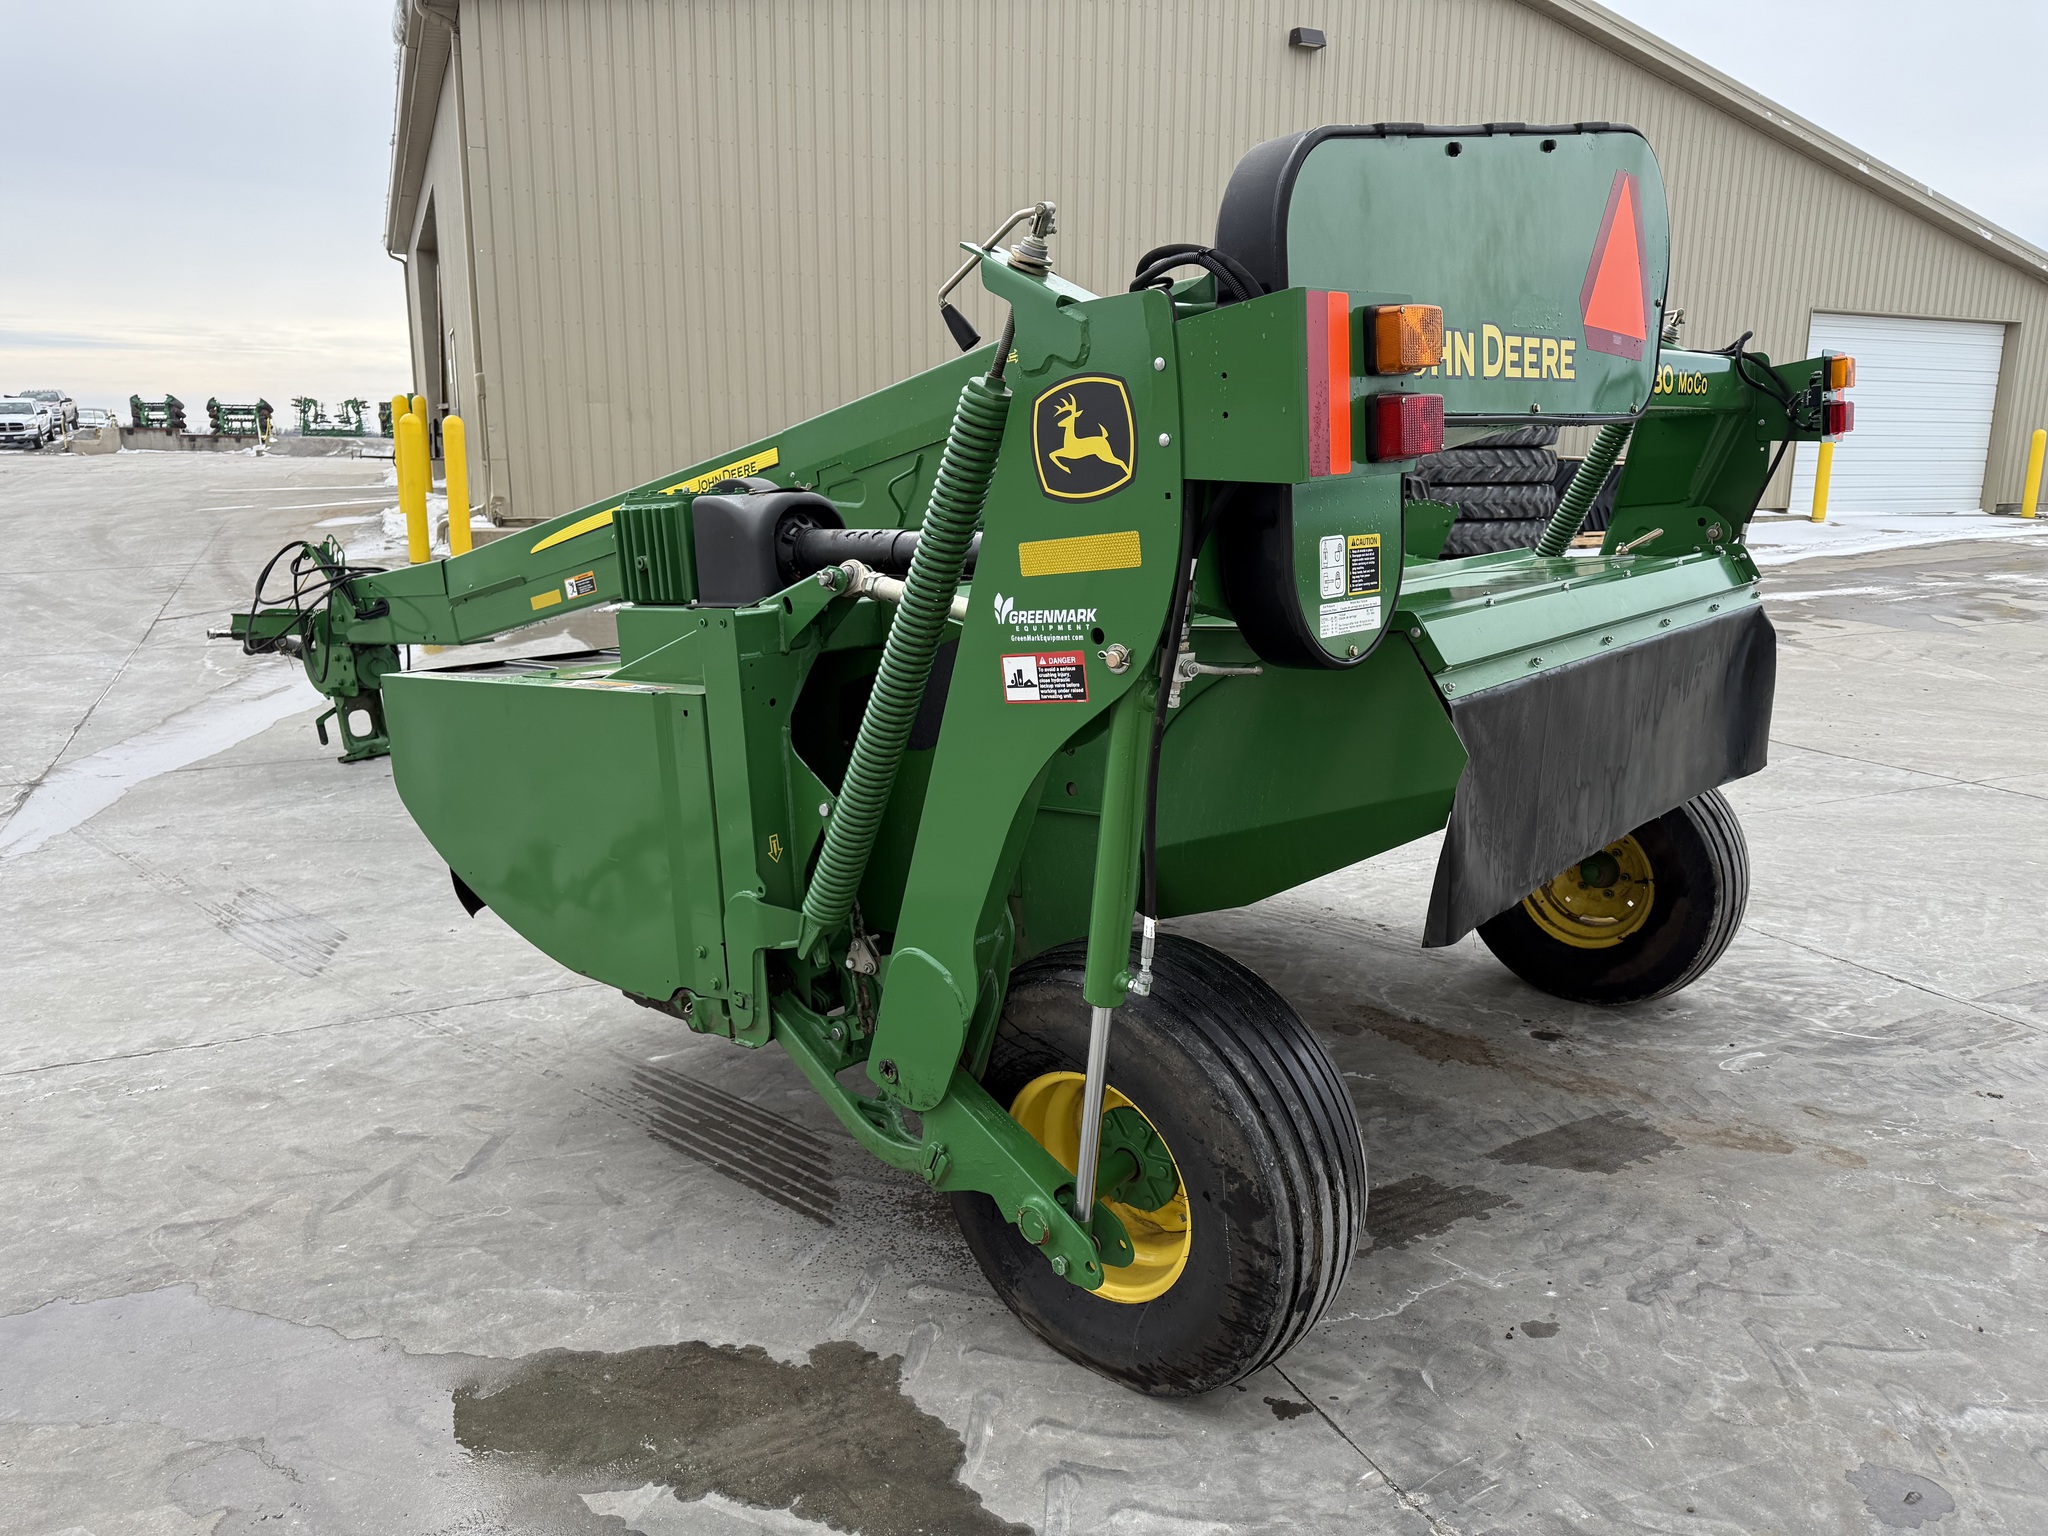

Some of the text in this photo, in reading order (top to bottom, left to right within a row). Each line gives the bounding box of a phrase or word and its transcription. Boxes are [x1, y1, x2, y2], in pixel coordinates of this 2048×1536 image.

[1482, 323, 1576, 380] DEERE
[1653, 363, 1708, 395] 30 MoCo
[722, 461, 758, 480] DEERE
[1009, 608, 1097, 624] GREENMARK
[1048, 656, 1076, 665] DANGER
